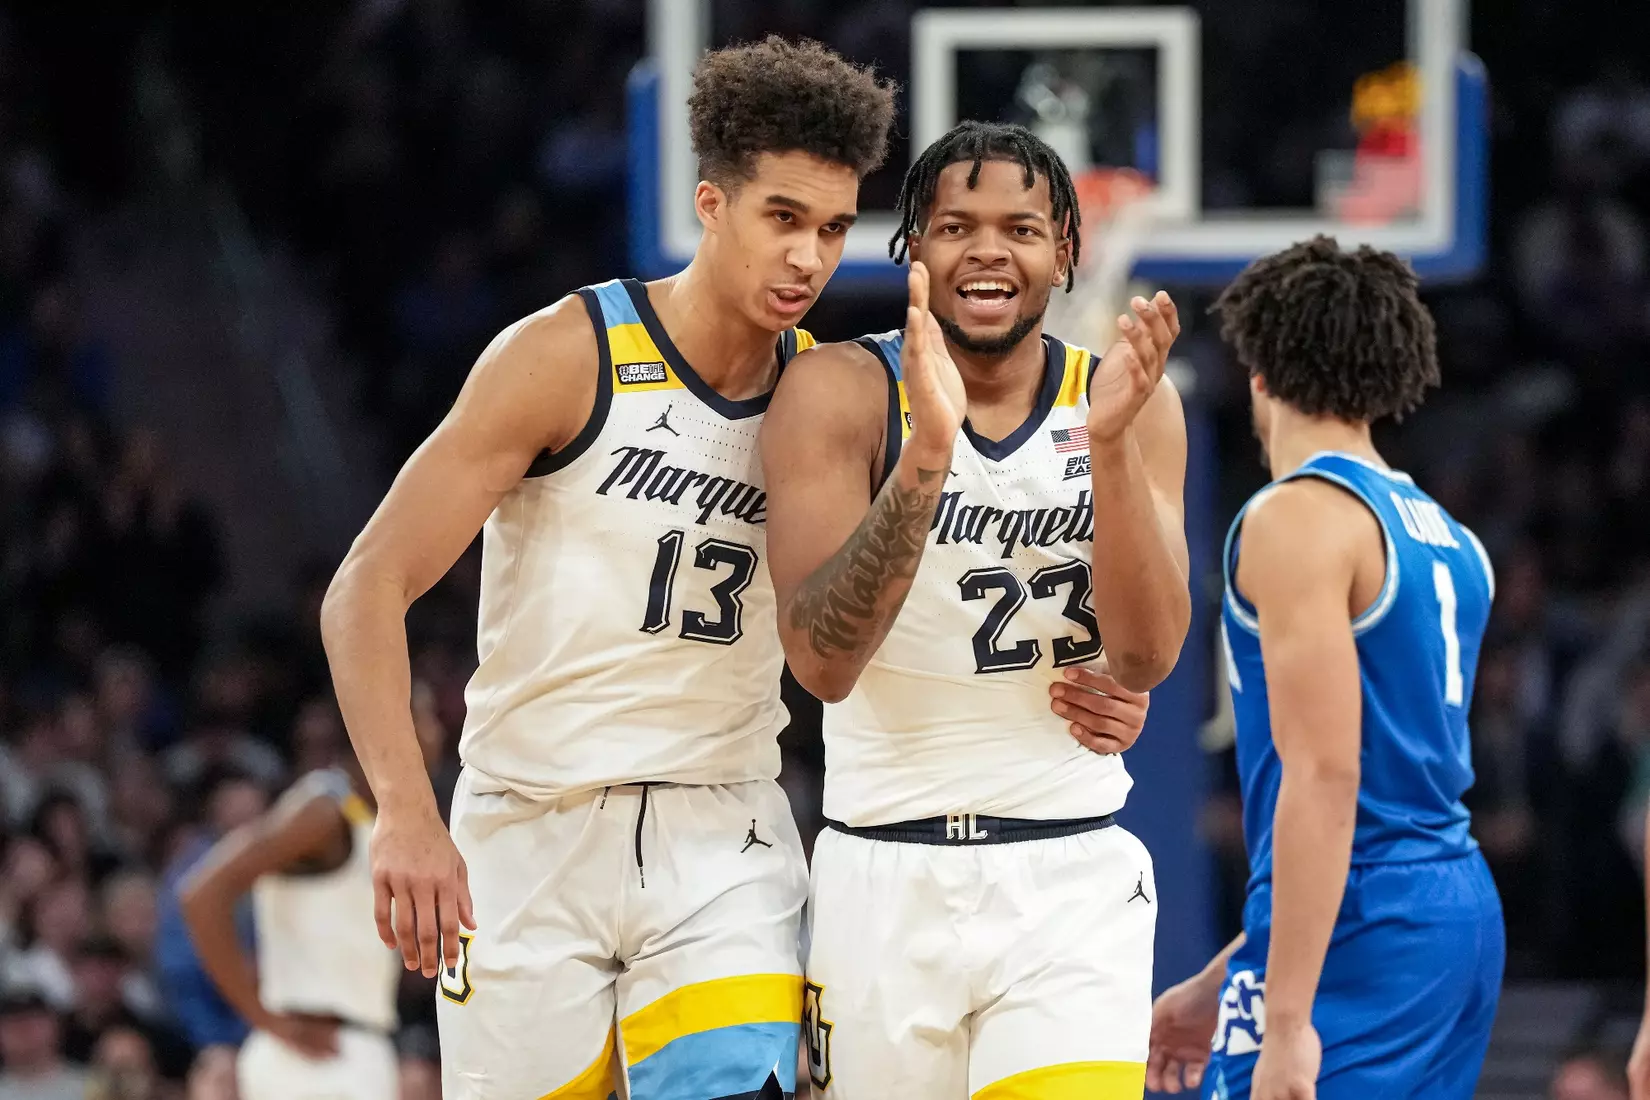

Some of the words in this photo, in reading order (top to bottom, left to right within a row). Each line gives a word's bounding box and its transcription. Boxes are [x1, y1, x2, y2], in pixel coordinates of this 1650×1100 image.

[621, 373, 665, 382] CHANGE
[596, 446, 767, 525] Marque
[1064, 464, 1092, 476] EAS
[1067, 455, 1091, 467] BIG
[930, 490, 1094, 559] Marquett
[639, 529, 759, 646] 13
[957, 558, 1104, 674] 23
[1432, 560, 1464, 708] 1
